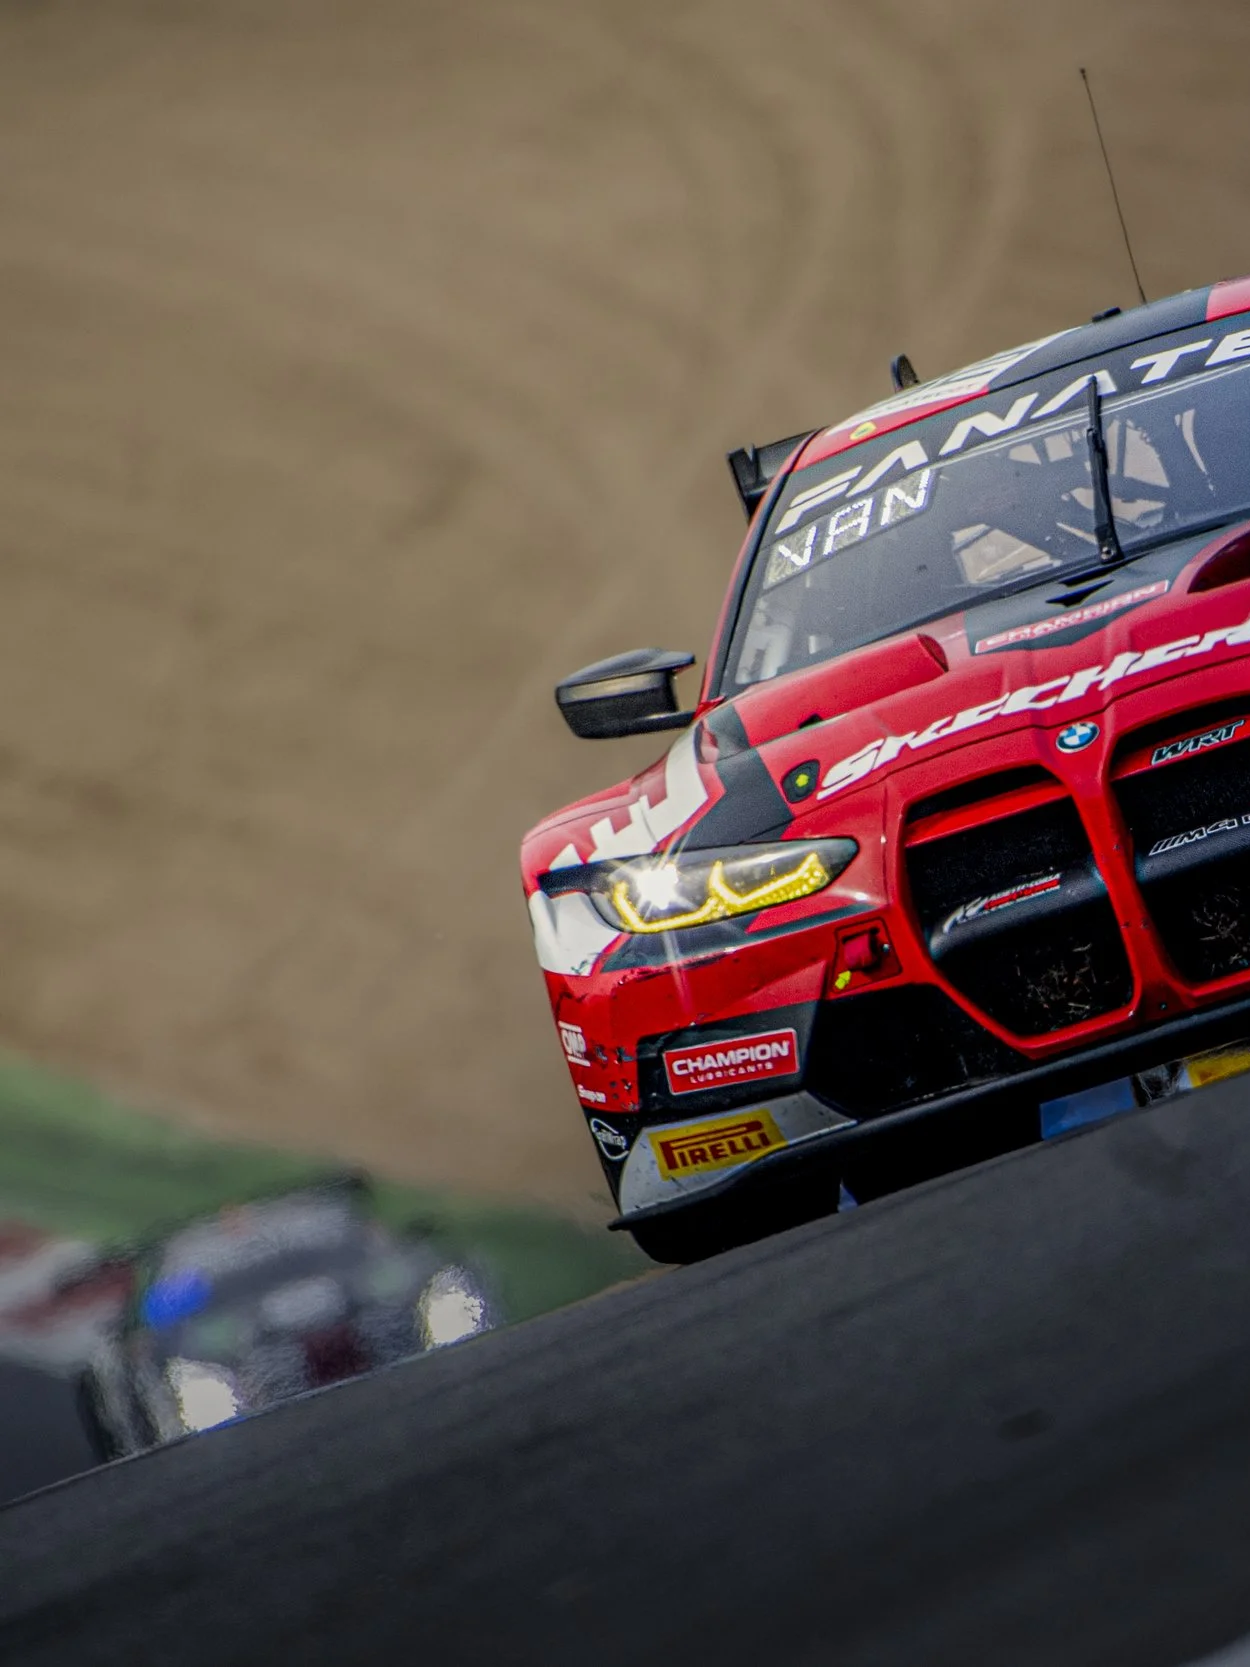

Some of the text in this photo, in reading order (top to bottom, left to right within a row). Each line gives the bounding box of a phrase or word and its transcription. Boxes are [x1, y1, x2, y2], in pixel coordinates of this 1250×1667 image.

[777, 469, 932, 566] VAN
[1151, 719, 1246, 766] WRT
[671, 1040, 791, 1076] CHAMPION
[689, 1062, 774, 1085] LUBRICANTS
[659, 1120, 773, 1171] PIRELLI
